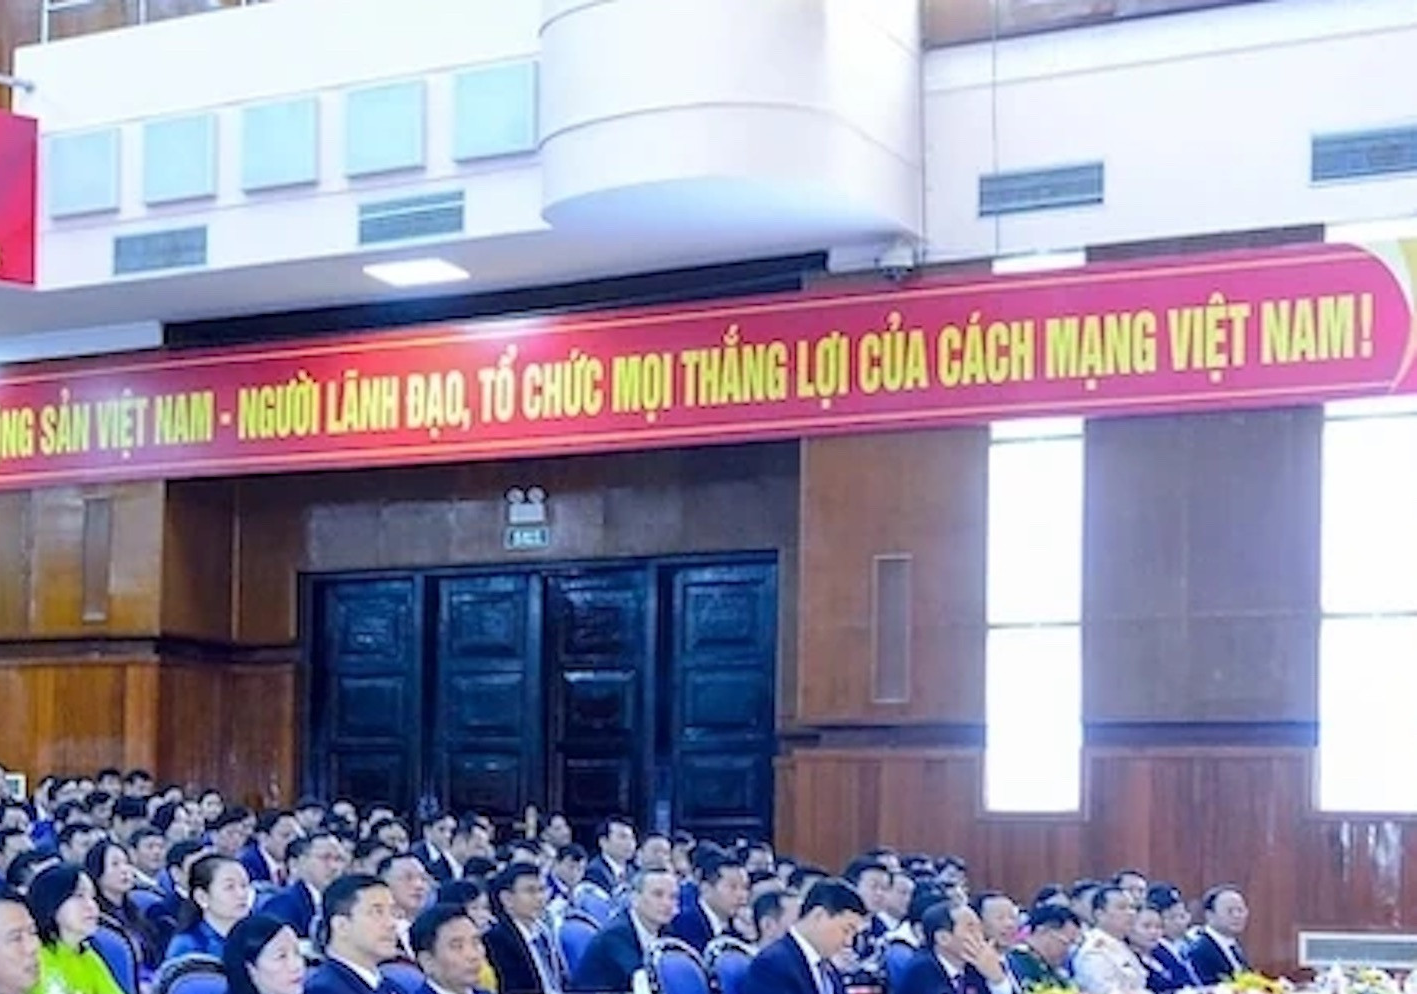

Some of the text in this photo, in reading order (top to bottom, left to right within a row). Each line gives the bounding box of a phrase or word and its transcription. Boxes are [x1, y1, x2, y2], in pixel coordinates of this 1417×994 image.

[39, 387, 90, 456] SẢN
[96, 387, 148, 459] VIỆT
[155, 391, 214, 445] NAM
[238, 368, 320, 440] NGƯỜI
[327, 369, 400, 432] LÃNH
[405, 370, 471, 438] ĐẠO,
[479, 343, 518, 423] TỔ
[523, 348, 603, 420] CHỨC
[613, 352, 672, 423] MỌI
[682, 324, 787, 404] THẮNG
[796, 331, 850, 410] LỢI
[859, 311, 929, 394] CỦA
[938, 310, 1034, 387] CÁCH
[1045, 310, 1156, 390] MẠNG
[1168, 293, 1251, 382] VIỆT
